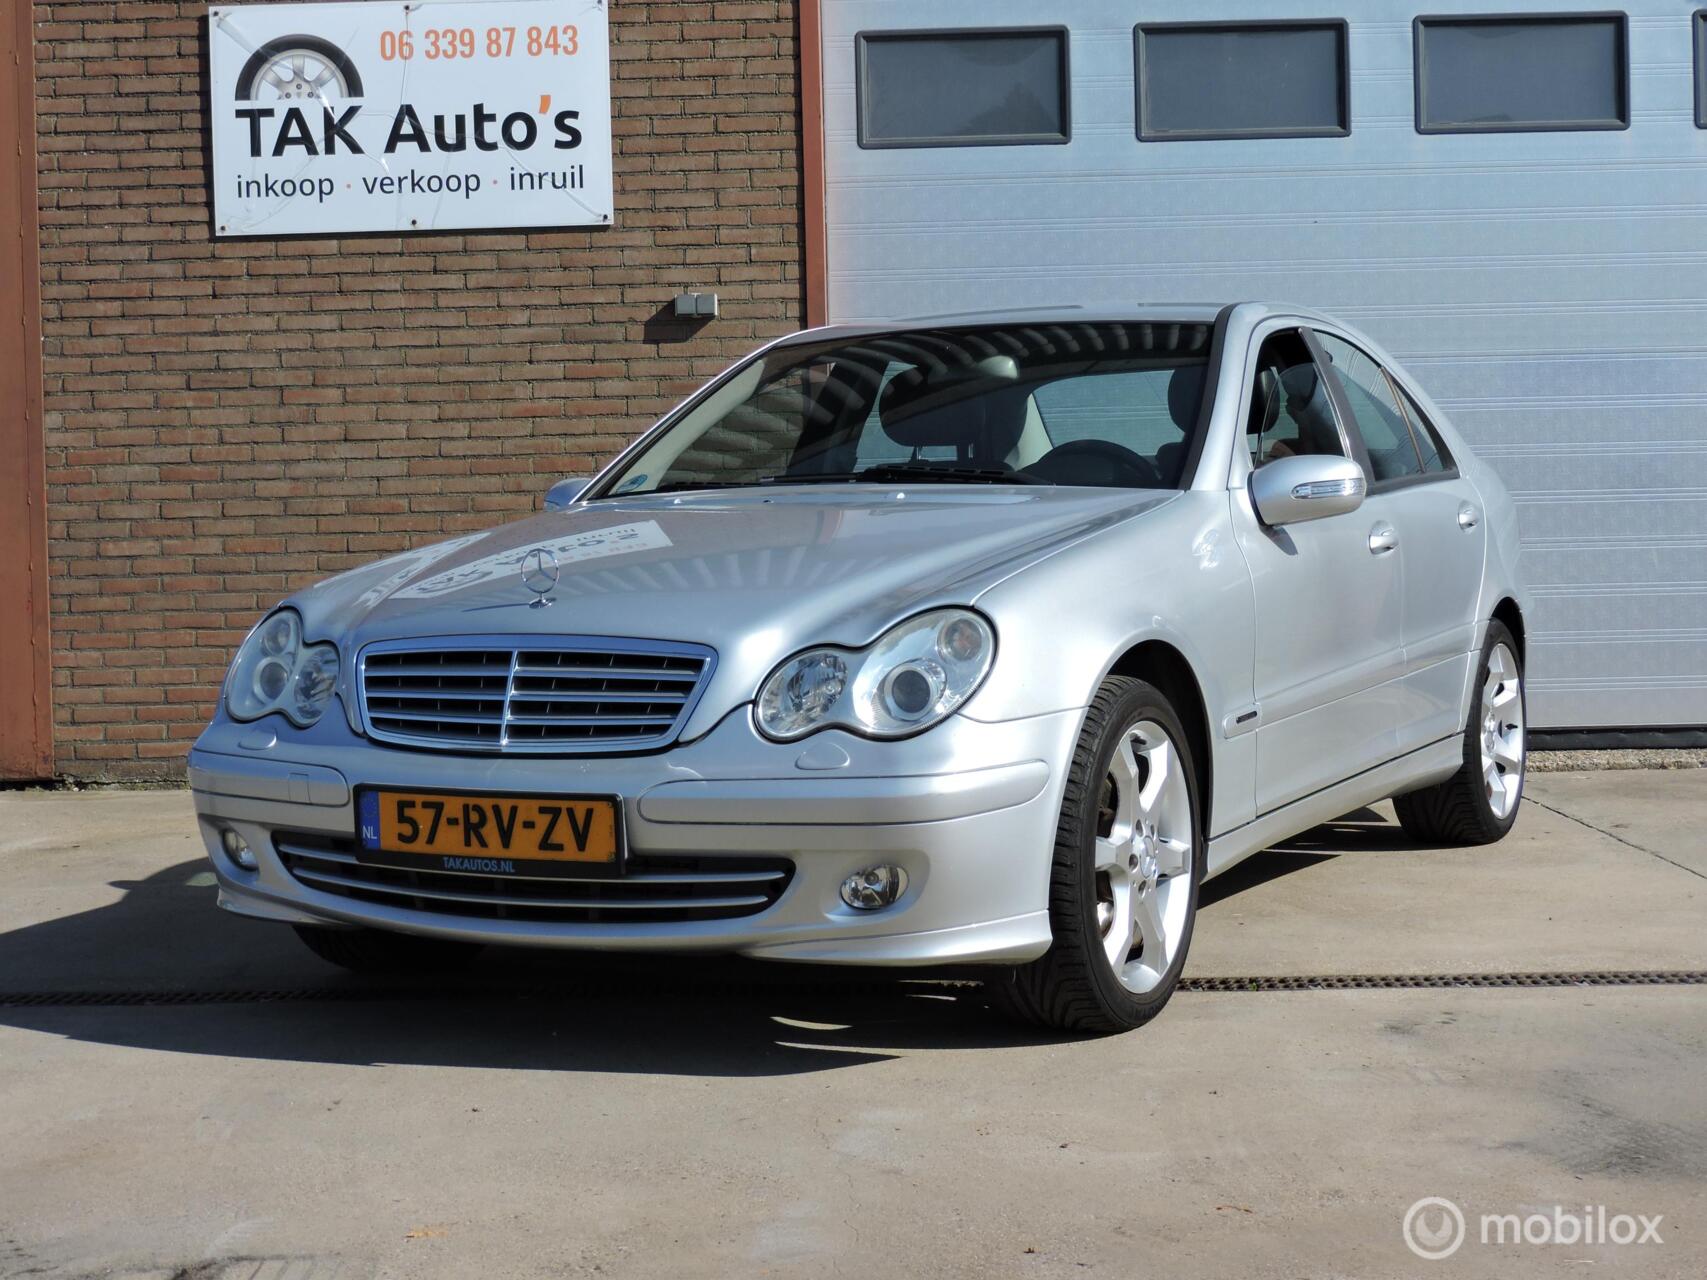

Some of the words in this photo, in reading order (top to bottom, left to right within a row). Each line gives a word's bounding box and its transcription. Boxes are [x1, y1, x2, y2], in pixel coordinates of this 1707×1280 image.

[380, 30, 415, 61] 06
[424, 28, 475, 60] 339
[486, 26, 517, 57] 87
[527, 24, 579, 56] 843
[234, 105, 365, 157] TAK
[236, 173, 335, 203] inkoop
[362, 169, 481, 199] verkoop
[509, 164, 584, 190] inruil
[362, 827, 378, 840] NL
[396, 799, 594, 852] 57-RV-ZV
[442, 856, 516, 873] TAKAUTOS.NL
